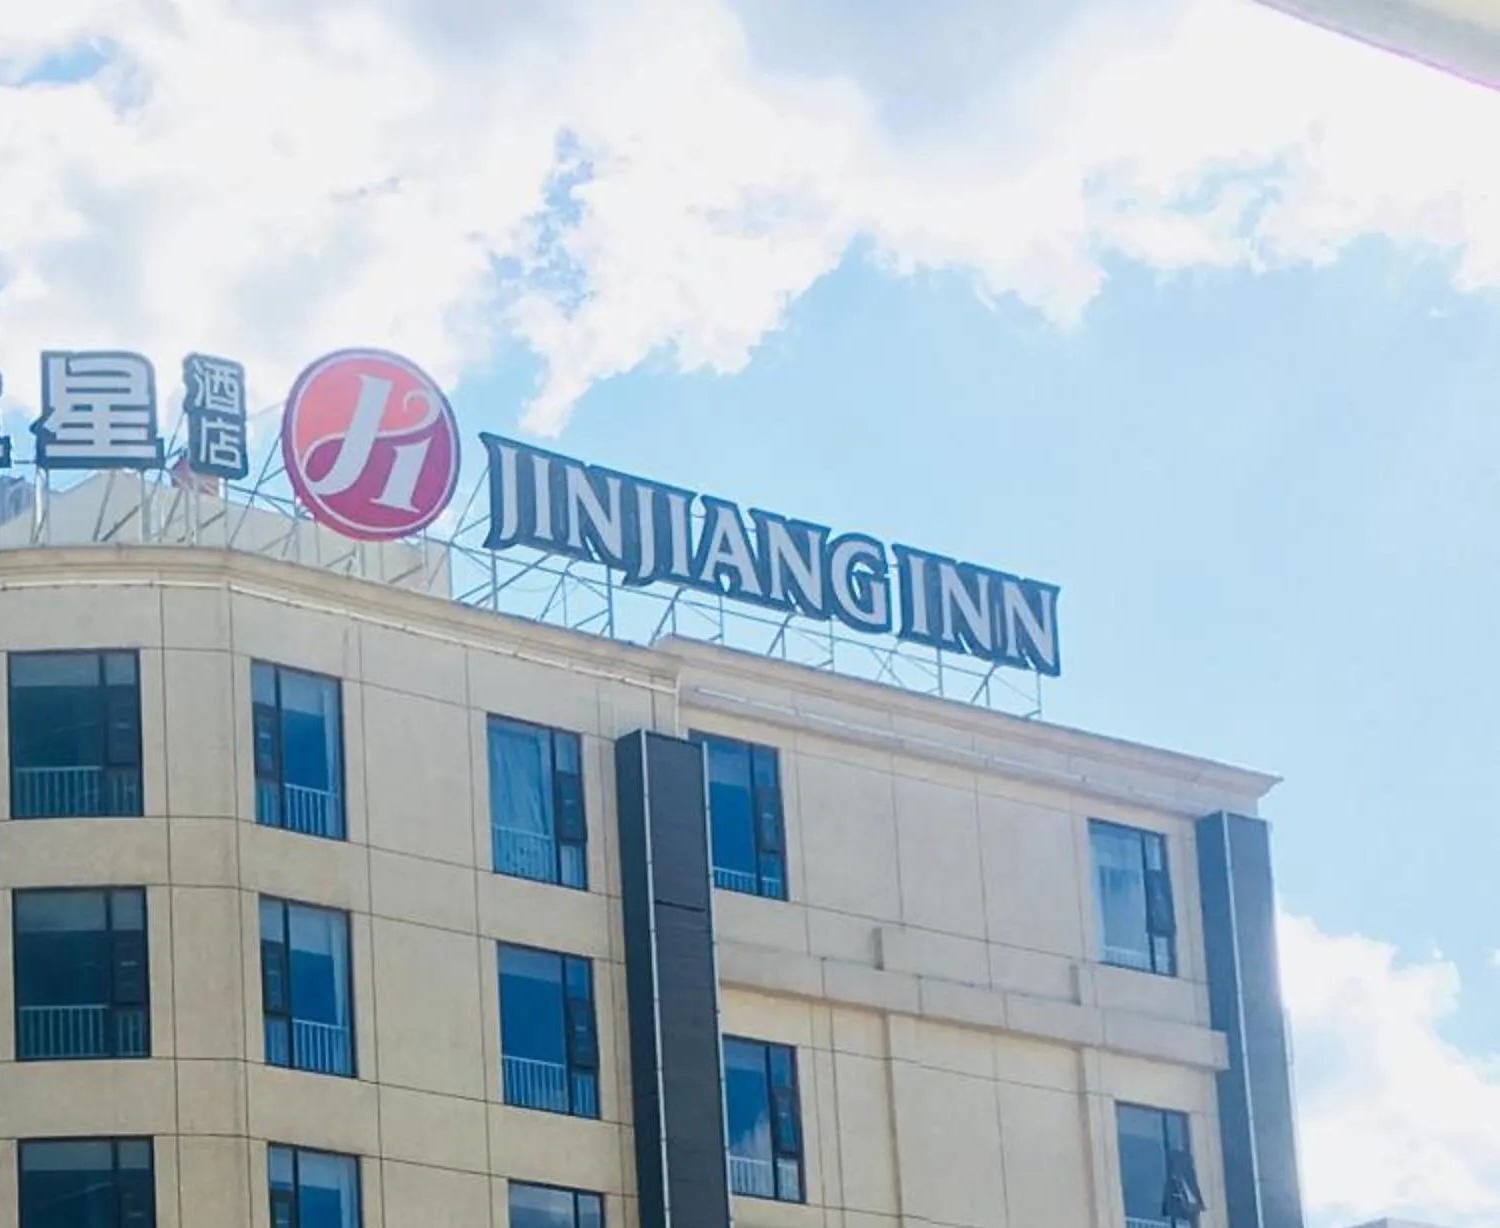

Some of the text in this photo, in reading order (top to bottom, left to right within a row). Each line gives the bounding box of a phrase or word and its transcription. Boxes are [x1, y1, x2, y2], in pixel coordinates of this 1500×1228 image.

[182, 352, 248, 479] 酒店
[479, 431, 1061, 677] JINJIANG INN
